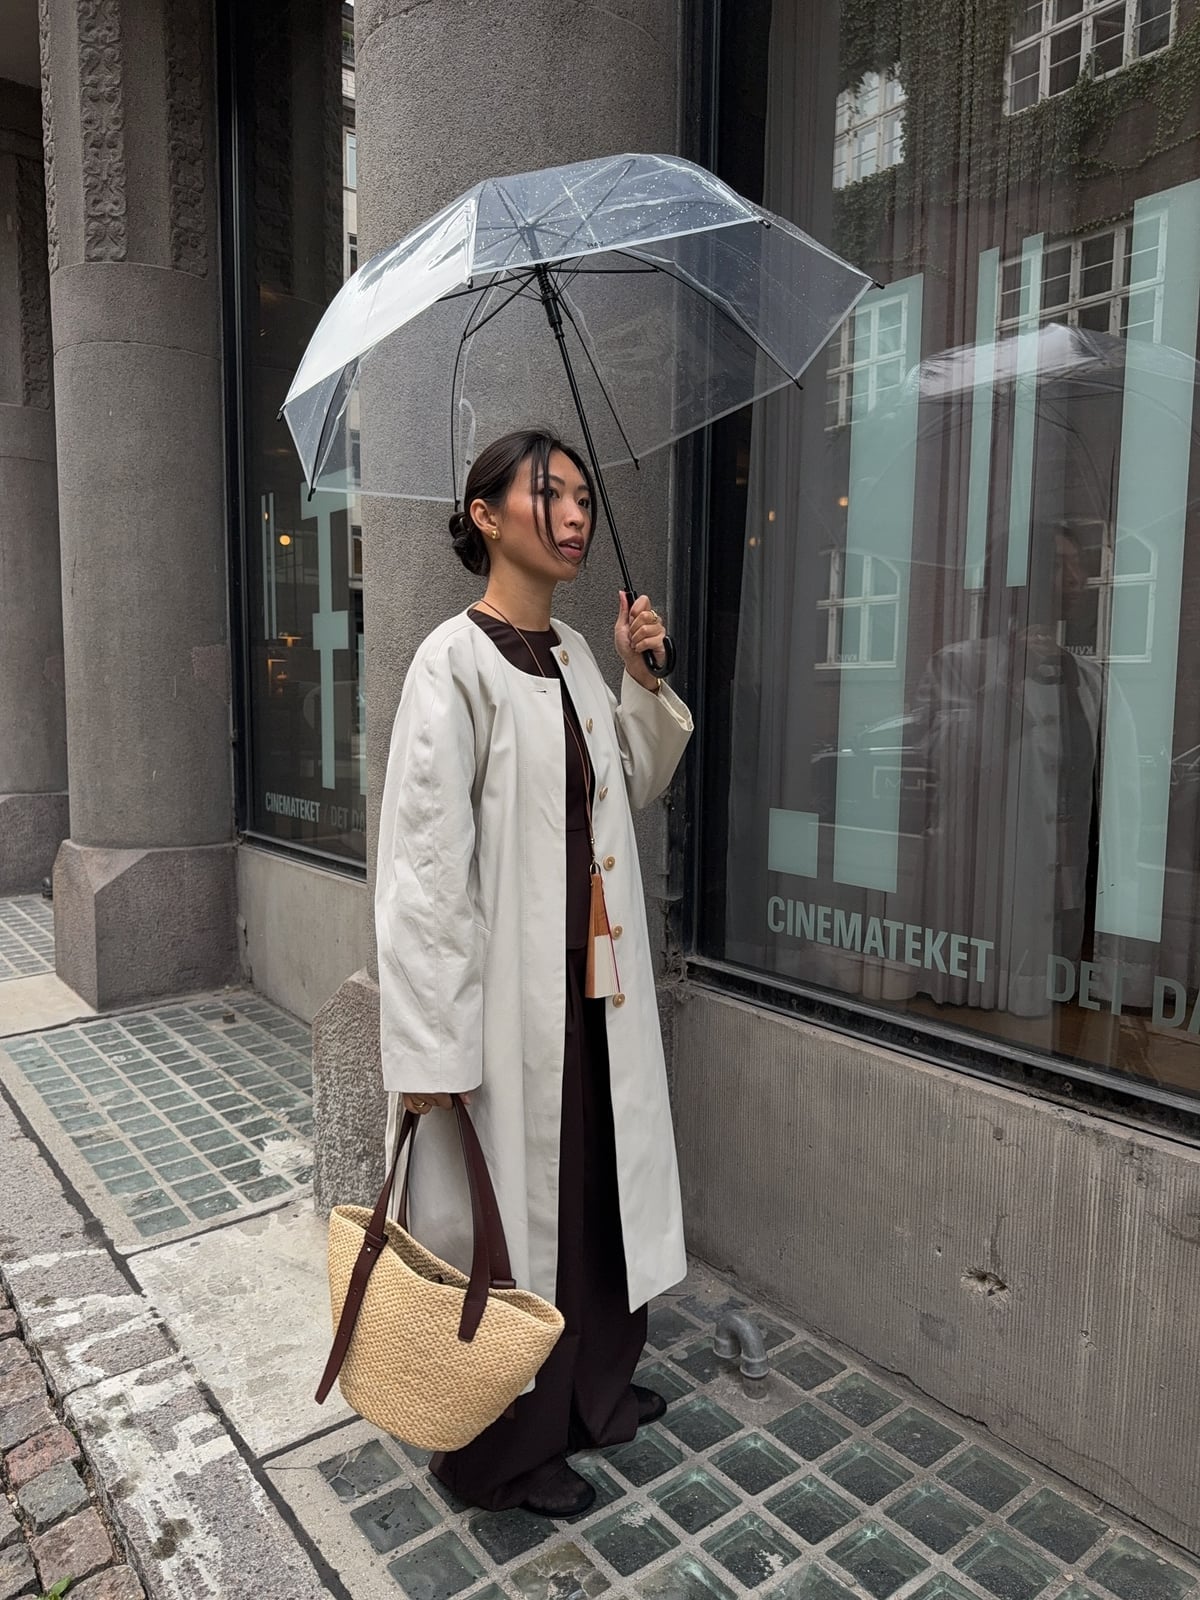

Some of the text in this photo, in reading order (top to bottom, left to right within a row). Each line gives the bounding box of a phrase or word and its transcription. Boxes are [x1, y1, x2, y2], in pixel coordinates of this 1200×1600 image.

[265, 791, 320, 823] CINEMATEKET
[330, 805, 349, 830] DET
[767, 896, 994, 984] CINEMATEKET
[1046, 953, 1130, 1016] DET
